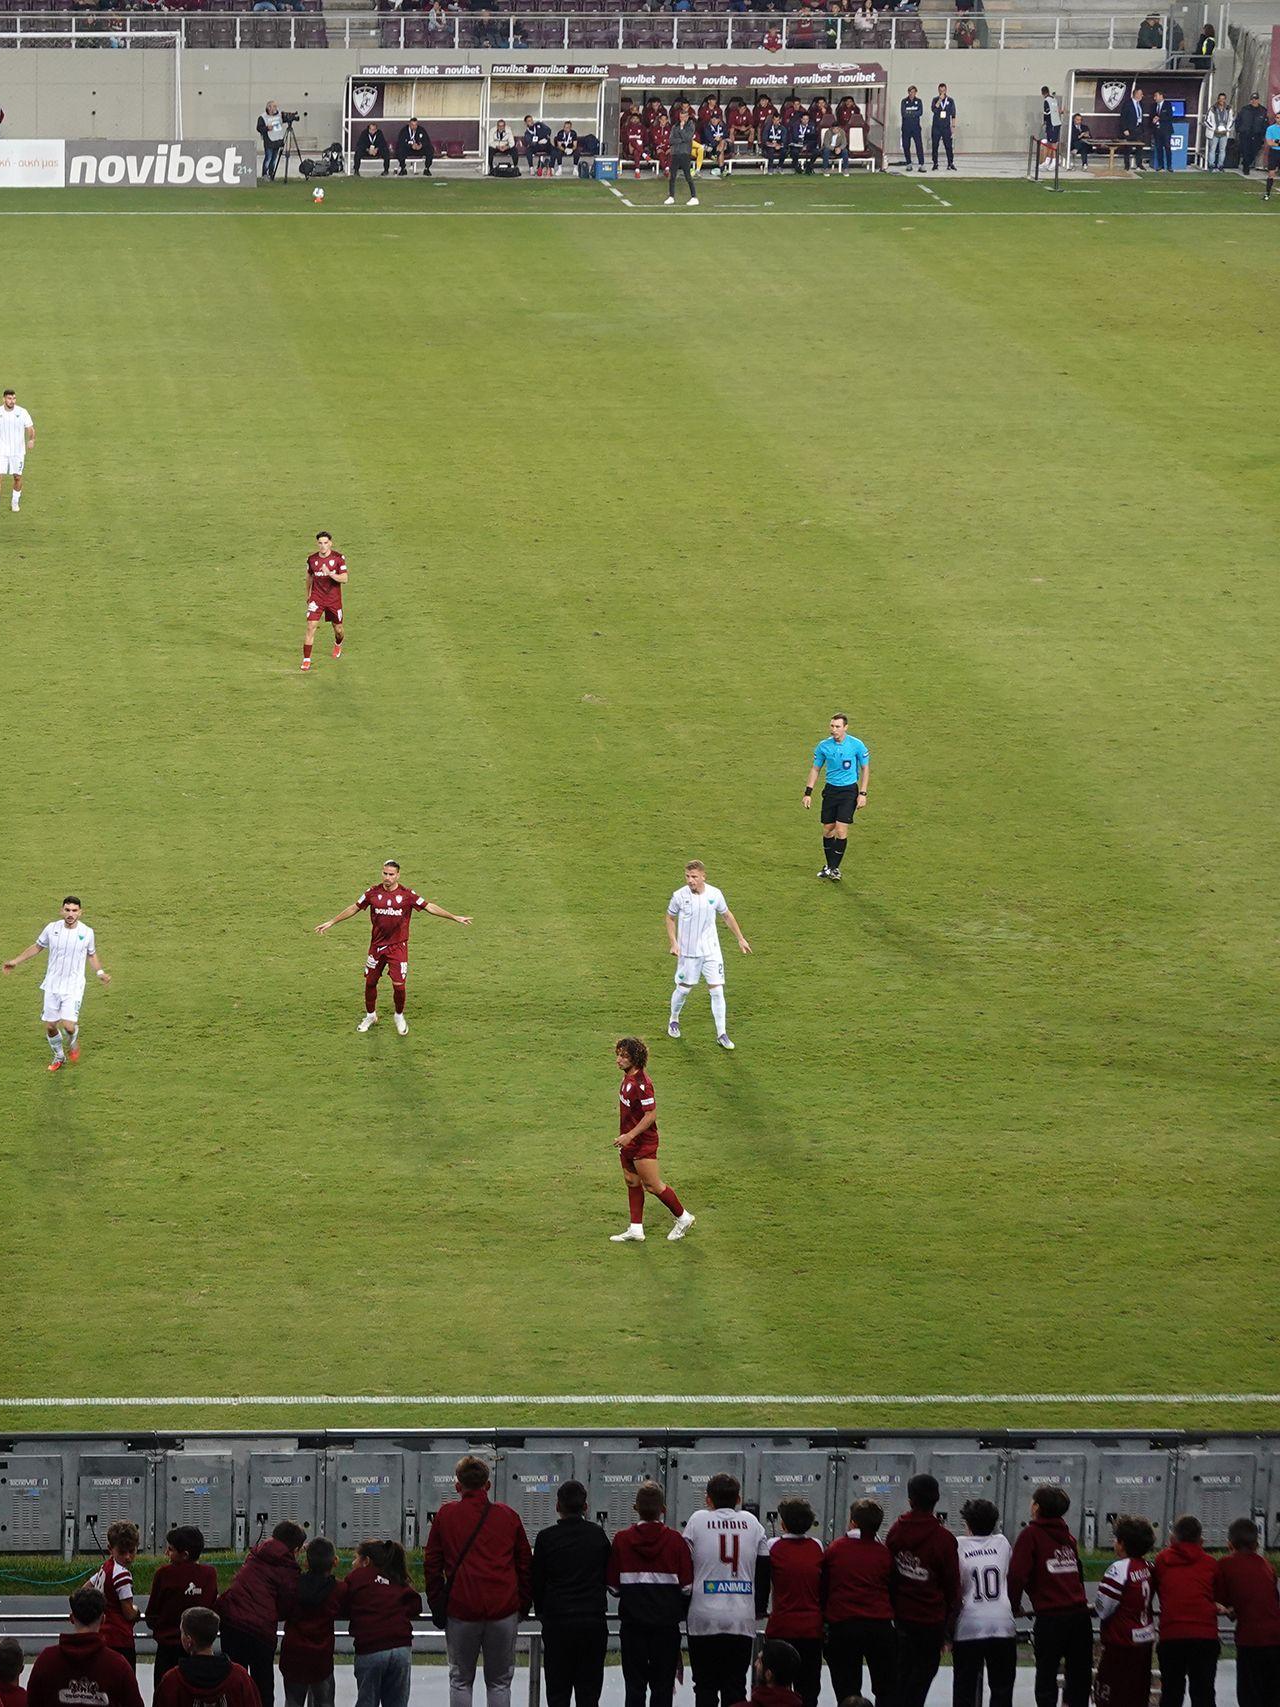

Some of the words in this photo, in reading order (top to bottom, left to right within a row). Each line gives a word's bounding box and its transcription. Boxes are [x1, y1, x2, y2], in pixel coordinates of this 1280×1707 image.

[363, 65, 398, 74] novibet
[404, 65, 439, 74] novibet
[445, 65, 480, 74] novibet
[493, 64, 528, 73] novibet
[533, 65, 568, 74] novibet
[573, 65, 609, 74] novibet
[620, 74, 656, 84] novibet
[661, 75, 697, 85] novibet
[702, 75, 738, 85] novibet
[750, 74, 788, 85] novibet
[794, 73, 832, 84] novibet
[838, 72, 876, 83] novibet
[69, 144, 243, 184] novibet
[236, 166, 253, 174] 21+
[374, 907, 403, 916] novibet
[707, 1520, 748, 1530] ILIADIS
[719, 1533, 740, 1578] 4
[717, 1582, 751, 1593] ANIMUS
[971, 1565, 1000, 1602] 10
